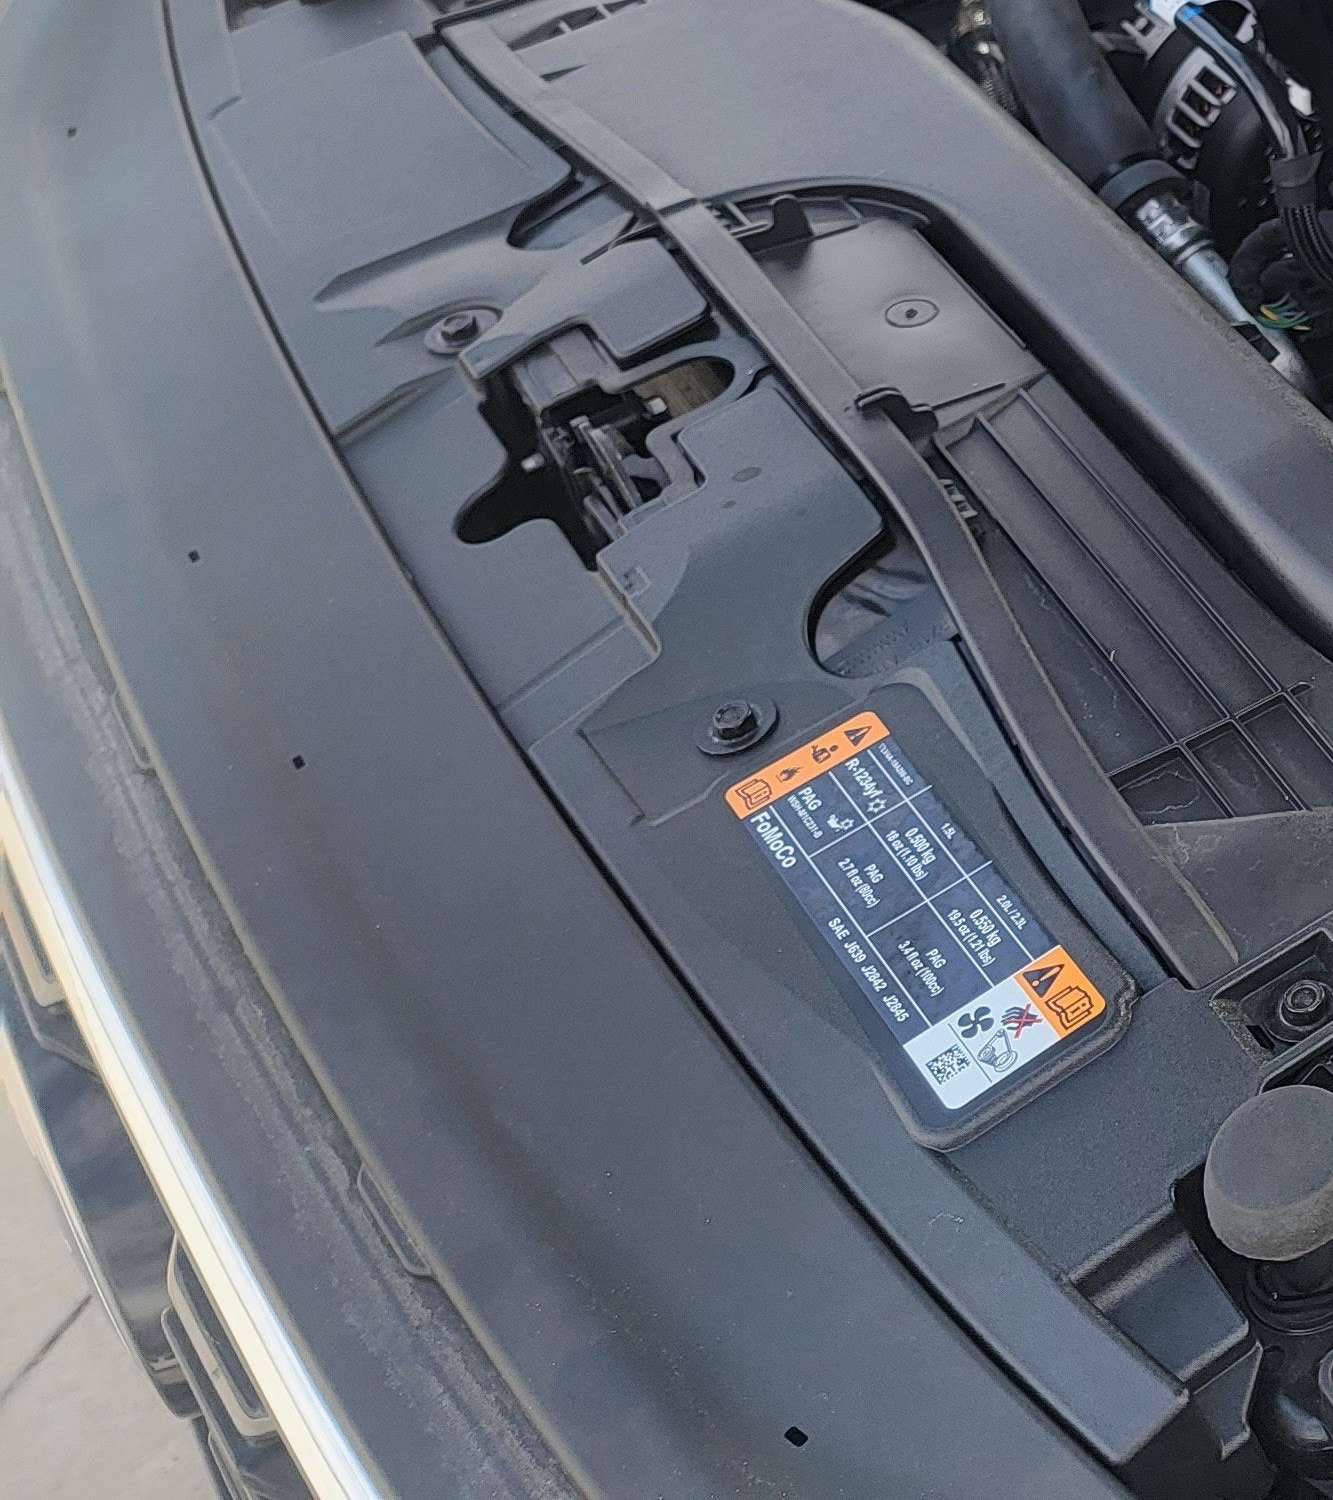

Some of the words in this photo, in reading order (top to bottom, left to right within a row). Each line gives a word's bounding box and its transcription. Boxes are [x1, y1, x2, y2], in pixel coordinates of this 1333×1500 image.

[840, 756, 884, 801] R-1234yf
[796, 785, 823, 812] PAG
[748, 810, 802, 870] FoMoCo
[883, 828, 900, 842] 18
[903, 826, 931, 853] 0.500
[938, 821, 958, 840] 1.5L
[890, 839, 903, 851] oz
[836, 856, 855, 872] 2.7
[894, 845, 919, 869] (1.10
[916, 847, 940, 866] kg
[848, 874, 863, 887] oz
[862, 862, 885, 884] PAG
[906, 861, 930, 882] lbs)
[853, 881, 882, 909] (80cc)
[945, 907, 967, 928] 19.5
[967, 907, 996, 936] 0.550
[995, 893, 1015, 913] 2.0L
[1009, 911, 1029, 930] 2.3L
[956, 923, 971, 936] oz
[981, 928, 1005, 948] kg
[896, 939, 915, 956] 3.4
[961, 930, 986, 954] (1.21
[909, 957, 924, 971] oz
[924, 947, 947, 969] PAG
[973, 946, 997, 968] lbs)
[826, 916, 851, 941] SAE
[842, 938, 868, 964] J639
[859, 961, 888, 993] J2842
[881, 991, 910, 1023] J2845
[913, 965, 945, 998] (100cc)
